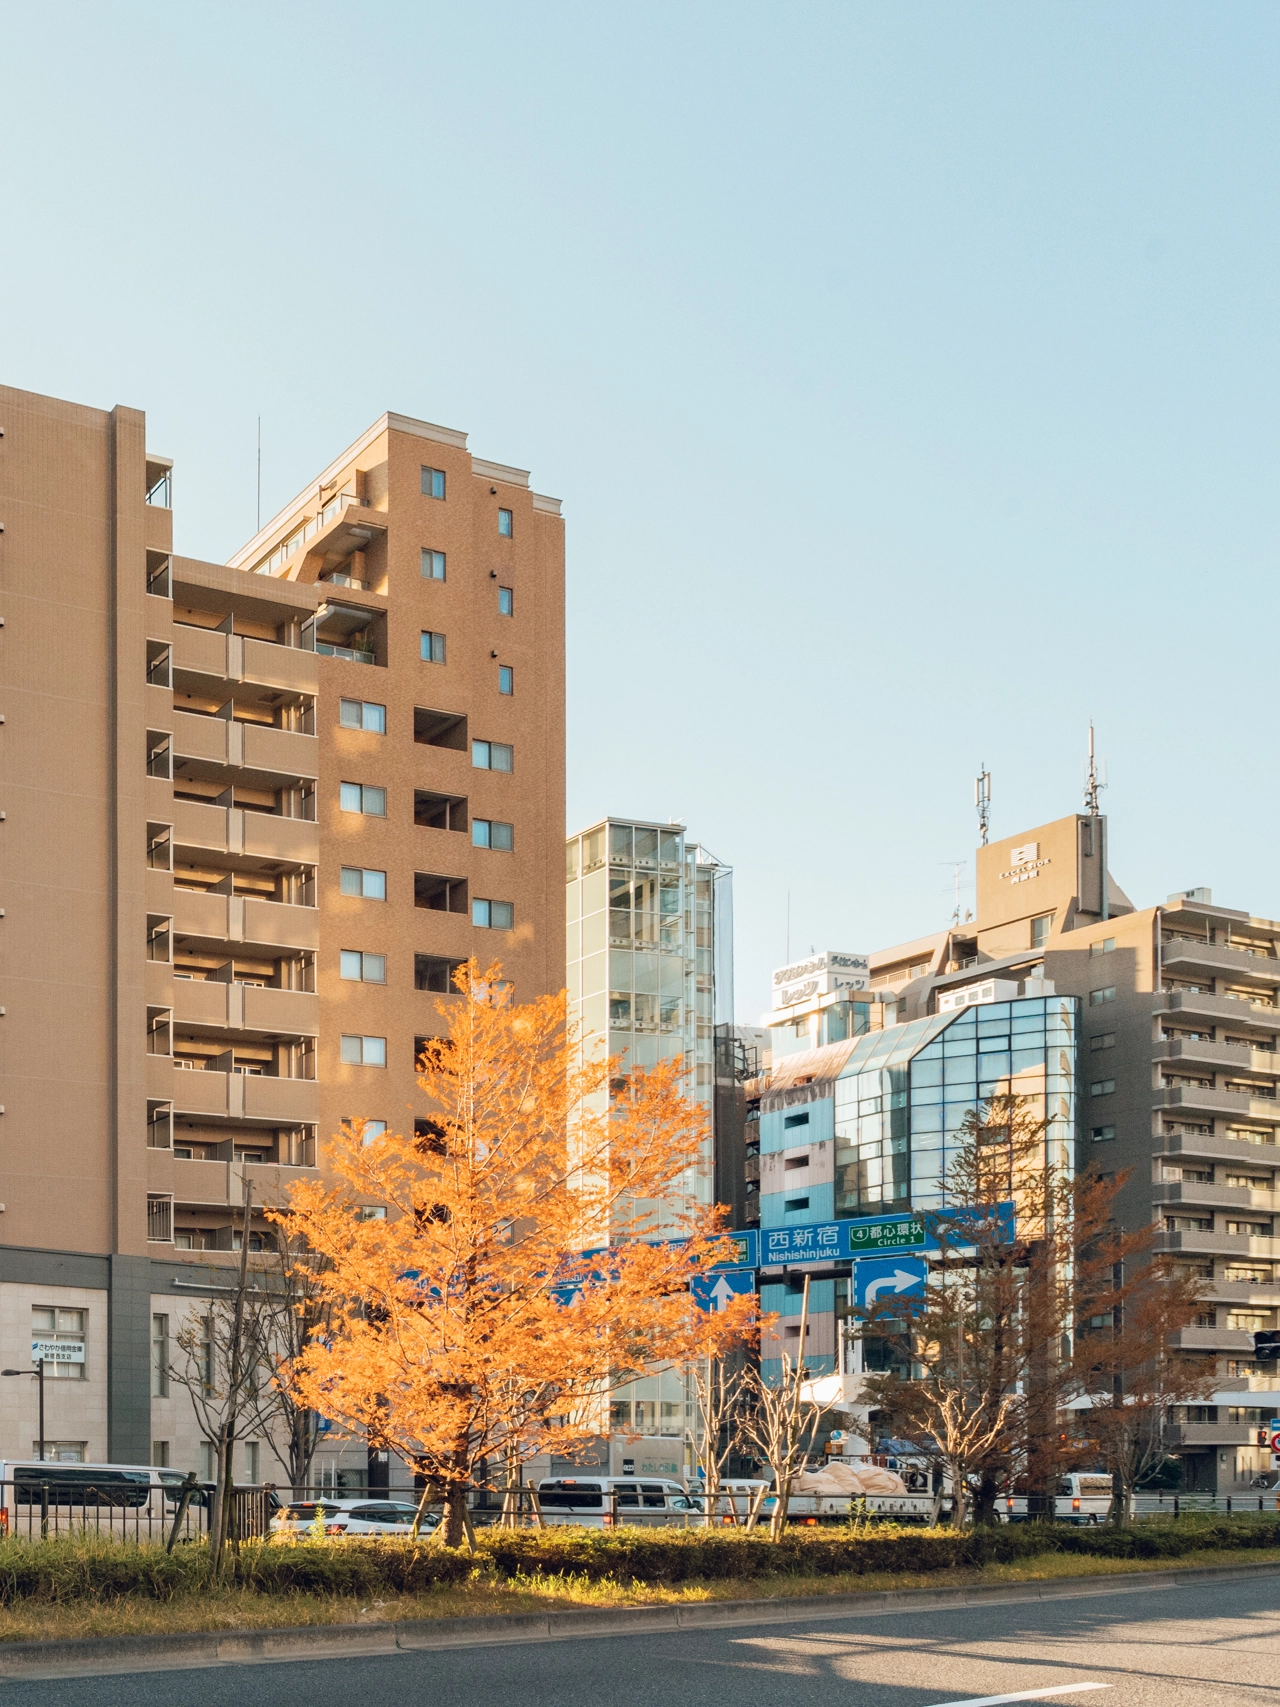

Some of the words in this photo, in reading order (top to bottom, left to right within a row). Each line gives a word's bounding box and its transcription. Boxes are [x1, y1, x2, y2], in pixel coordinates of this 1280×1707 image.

[768, 1225, 840, 1250] 西新宿
[856, 1230, 864, 1239] 4
[869, 1222, 924, 1240] 都心環状
[877, 1237, 906, 1247] Circle
[909, 1236, 916, 1244] 1
[768, 1247, 840, 1262] Nishishinjuku
